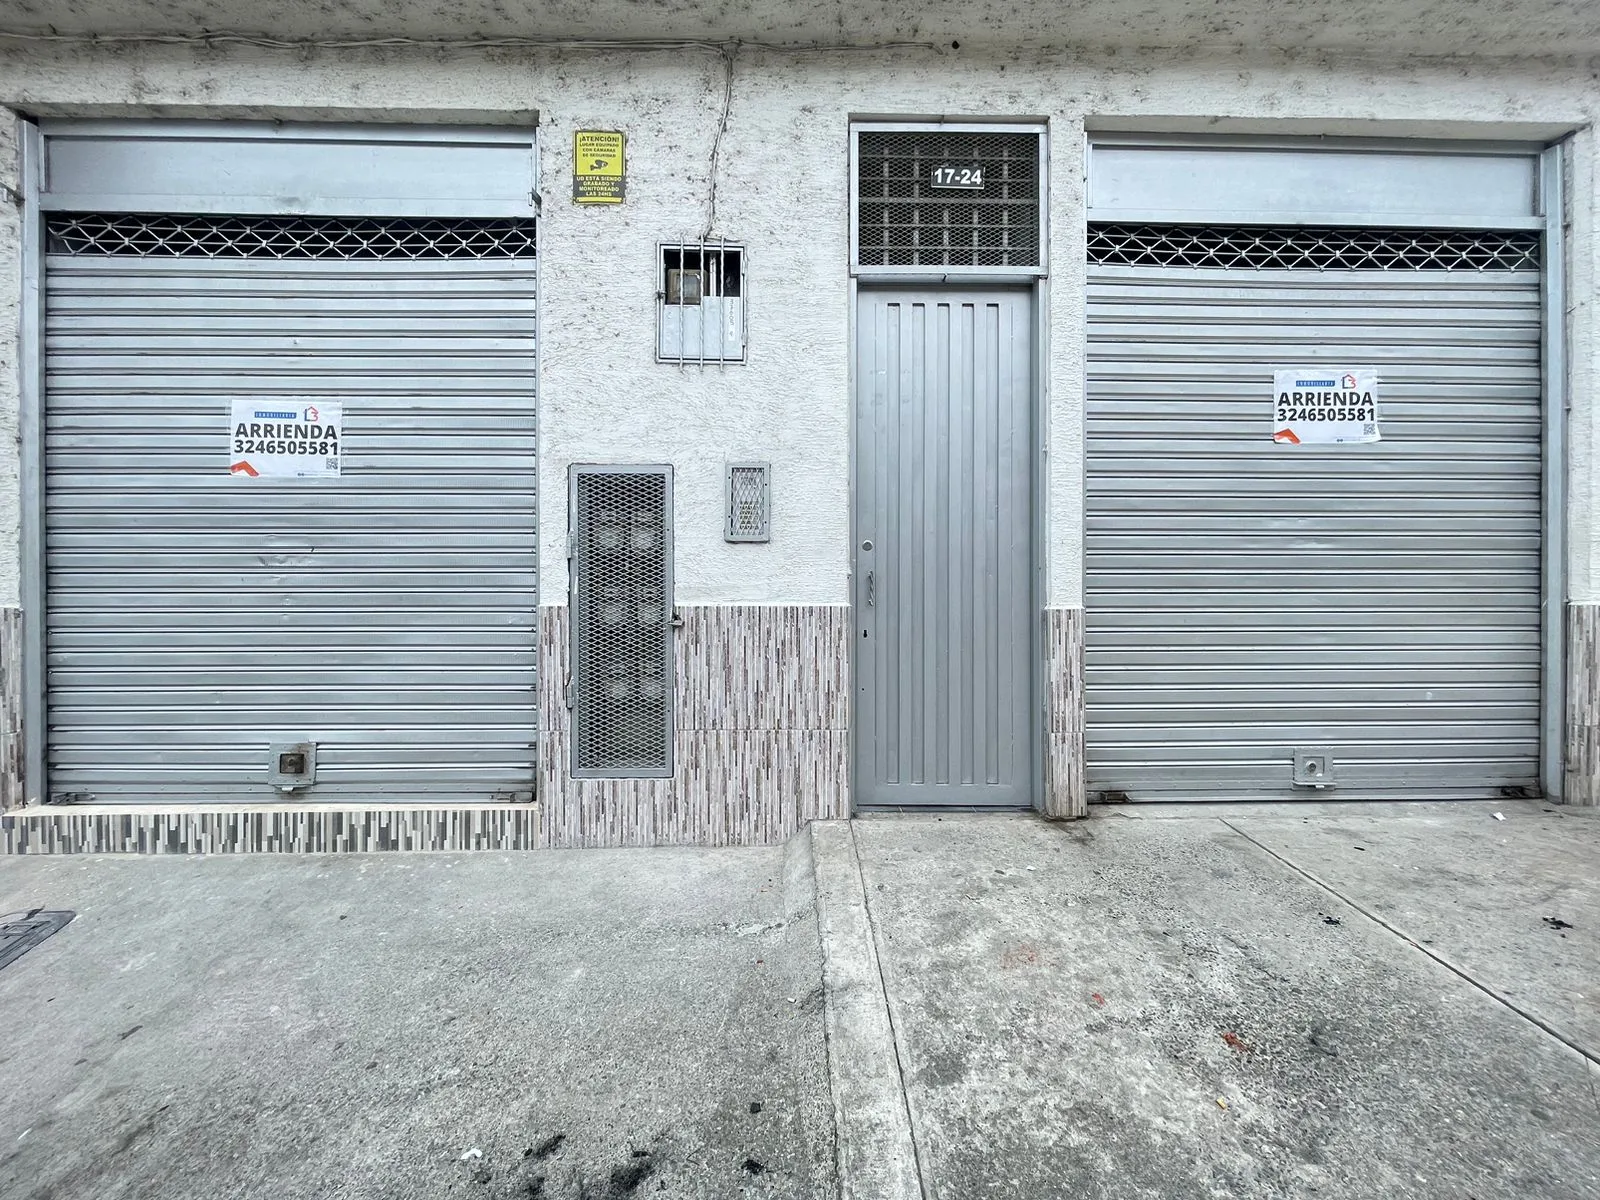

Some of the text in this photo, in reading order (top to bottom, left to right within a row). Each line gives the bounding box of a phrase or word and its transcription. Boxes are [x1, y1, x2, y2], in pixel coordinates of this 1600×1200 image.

[934, 168, 982, 185] 17-24
[1278, 392, 1374, 406] ARRIENDA
[1278, 408, 1374, 421] 3246505581
[235, 423, 337, 440] ARRIENDA
[234, 440, 338, 455] 3246505581
